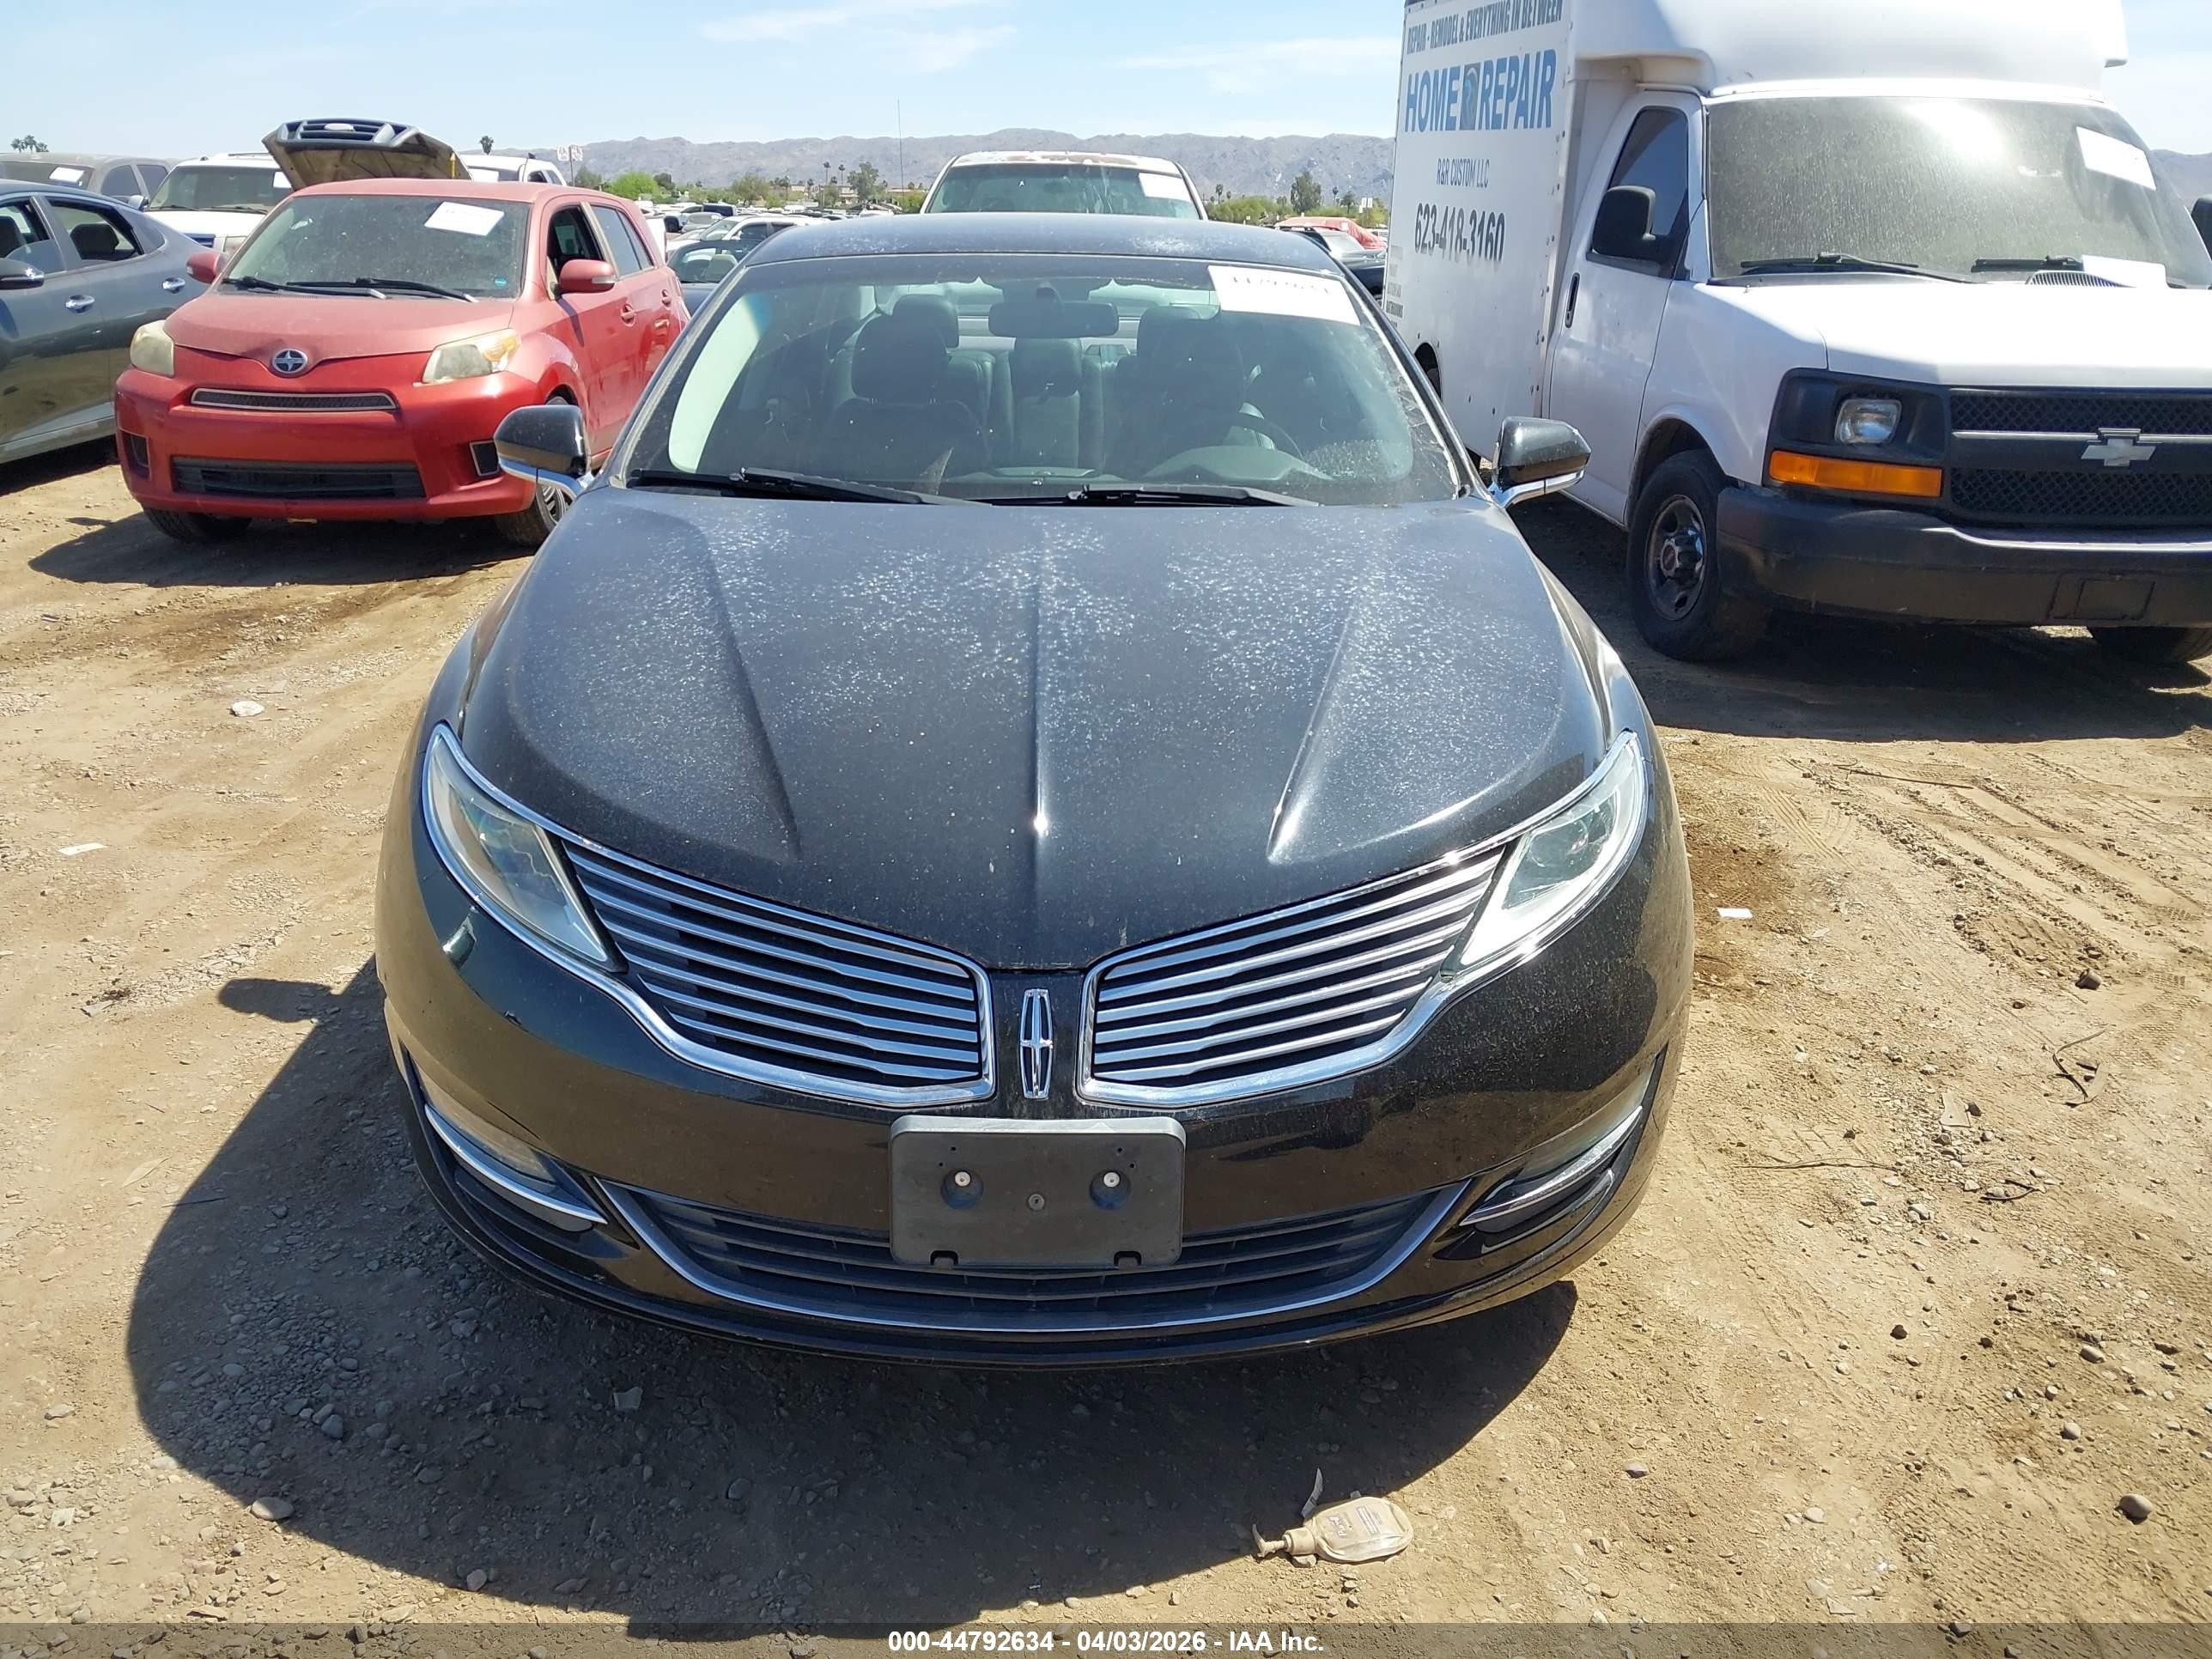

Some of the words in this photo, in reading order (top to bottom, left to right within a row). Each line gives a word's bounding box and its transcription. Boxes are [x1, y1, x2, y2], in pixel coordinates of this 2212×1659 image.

[1407, 23, 1427, 55] REPAIR
[1430, 14, 1460, 49] REMODEL
[1460, 16, 1465, 43] &
[1465, 5, 1510, 41] EVERYTHING
[1510, 1, 1523, 31] IN
[1521, 0, 1563, 29] BETWEEN
[1405, 66, 1461, 132] HOME
[1479, 49, 1557, 131] REPAIR
[1437, 158, 1449, 185] R&R
[1450, 158, 1477, 187] CUSTOM
[1476, 158, 1490, 189] LLC
[1414, 203, 1505, 264] 623-418-3160
